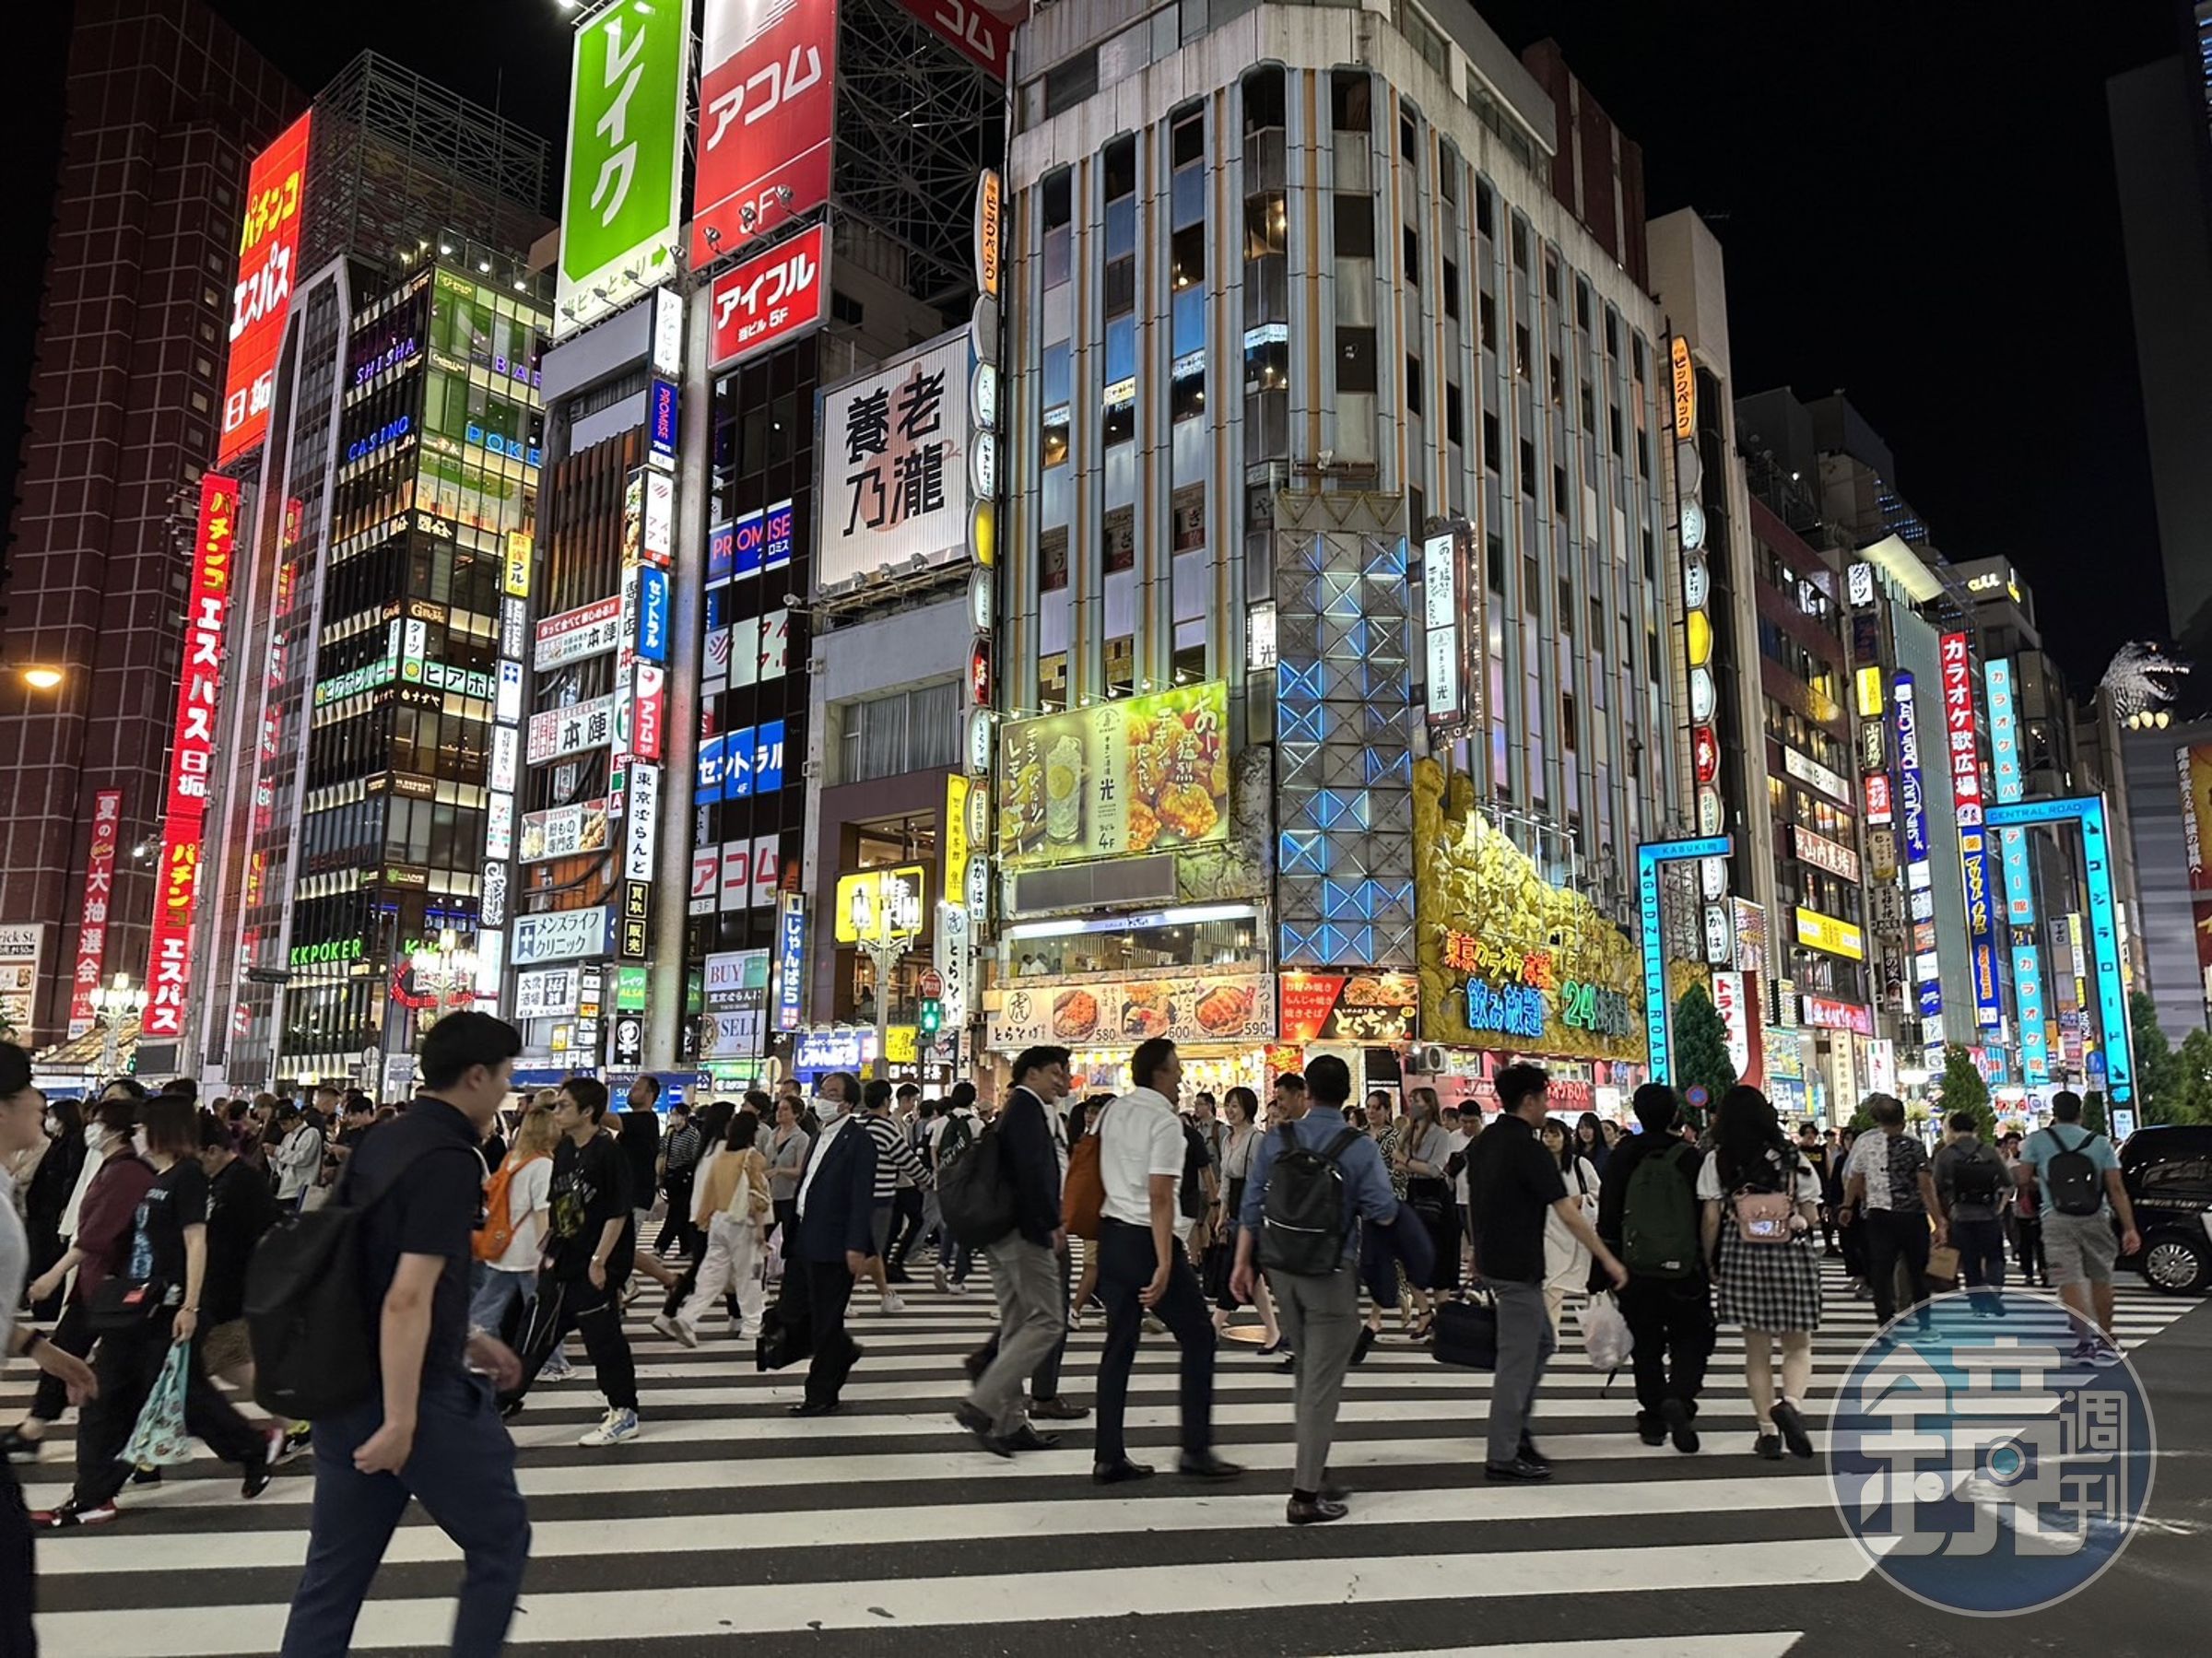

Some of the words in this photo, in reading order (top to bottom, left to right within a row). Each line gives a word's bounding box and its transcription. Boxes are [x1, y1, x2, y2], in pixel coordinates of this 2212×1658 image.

[706, 43, 822, 151] アコム
[591, 17, 646, 228] レイク
[240, 171, 300, 256] パチンコ
[229, 241, 292, 342] エスパス
[716, 253, 815, 329] アイフル
[356, 337, 415, 385] SHISHA
[657, 387, 671, 439] PROMISE
[347, 416, 409, 462] CASINO
[202, 492, 230, 589] パチンコ
[712, 512, 791, 560] PROMISE
[1968, 573, 2000, 592] au
[646, 580, 662, 648] セントラル
[409, 624, 422, 653] ダーツ
[183, 597, 222, 743] エスパス
[641, 700, 655, 743] アコム
[1944, 640, 1979, 796] カラオケ歌広場
[700, 742, 782, 784] セントラル
[1990, 805, 2045, 821] CENTRAL
[2048, 803, 2084, 816] ROAD
[1099, 832, 1115, 851] 4F
[165, 843, 196, 928] パチンコ
[693, 847, 778, 894] アコム
[629, 886, 643, 914] 買取
[696, 900, 711, 912] 3F
[535, 934, 586, 958] クリニック
[536, 911, 599, 936] メンズライフ
[628, 925, 642, 953] 販売
[1641, 880, 1662, 997] GODZILLA
[290, 938, 363, 965] KKPOKER
[710, 964, 742, 984] BUY
[783, 917, 802, 1005] じゃんぱら
[152, 938, 184, 1030] エスパス
[1258, 976, 1269, 1020] かつ丼
[720, 1016, 760, 1040] SELL
[1096, 1028, 1116, 1041] 580
[1169, 1025, 1190, 1039] 600
[1245, 1022, 1268, 1036] 590
[1333, 1007, 1407, 1036] とらちゅう
[1648, 1009, 1665, 1066] ROAD
